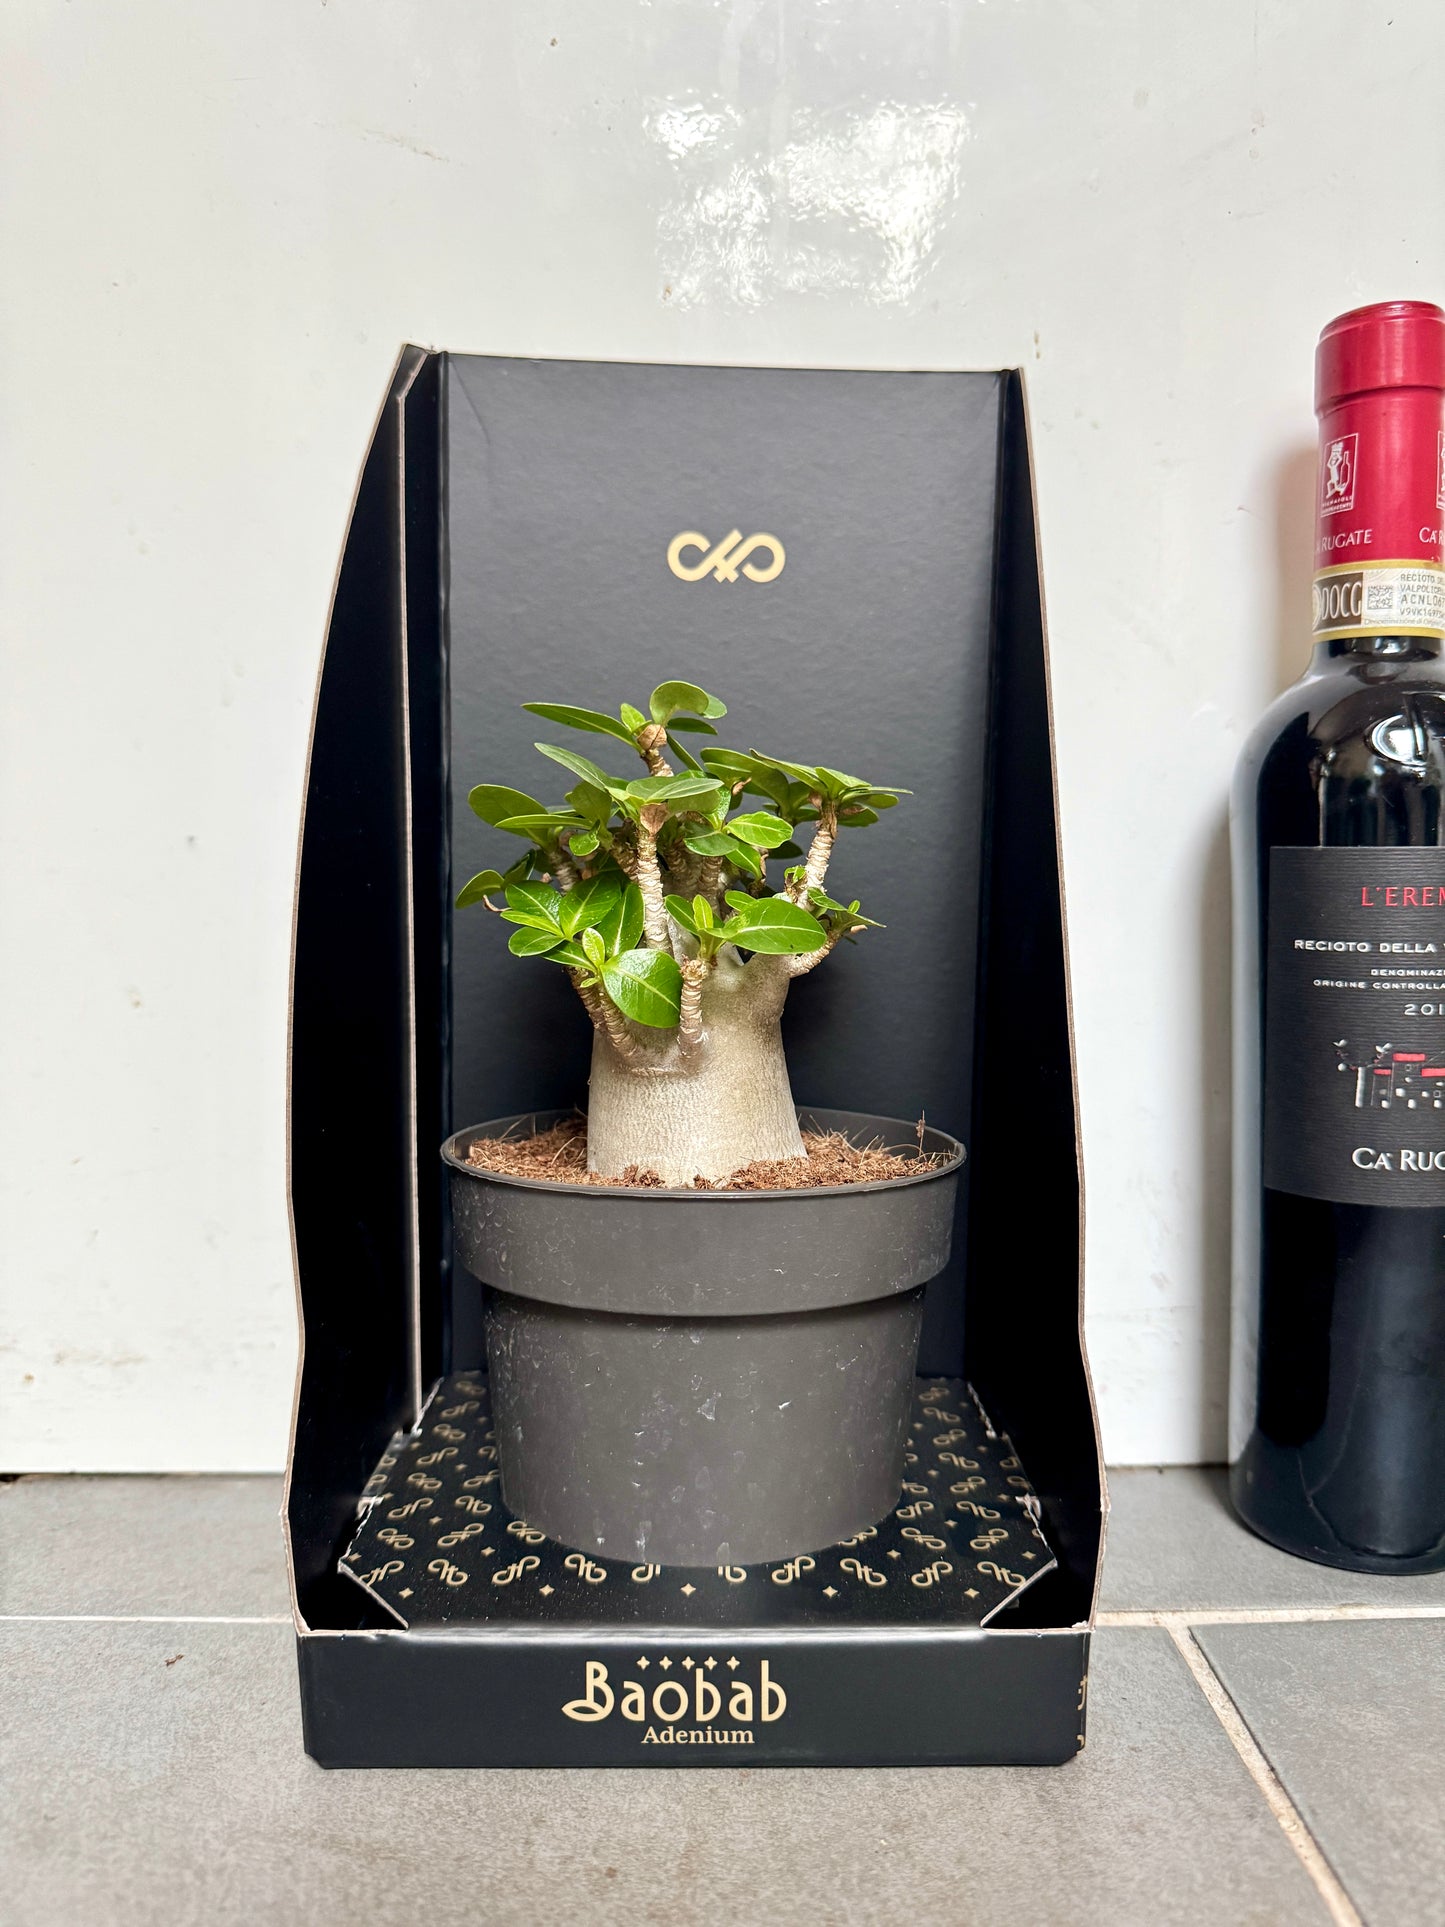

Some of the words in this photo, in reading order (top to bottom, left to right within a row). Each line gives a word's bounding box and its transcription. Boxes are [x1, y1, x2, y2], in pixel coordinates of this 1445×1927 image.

[1400, 573, 1436, 583] RECIOTO
[1321, 581, 1362, 620] DOCG
[1294, 939, 1371, 953] RECIOTO
[1379, 942, 1437, 953] DELLA
[1313, 979, 1366, 989] ORIGINE
[561, 1660, 787, 1722] Baobab
[641, 1725, 755, 1744] Adenium
